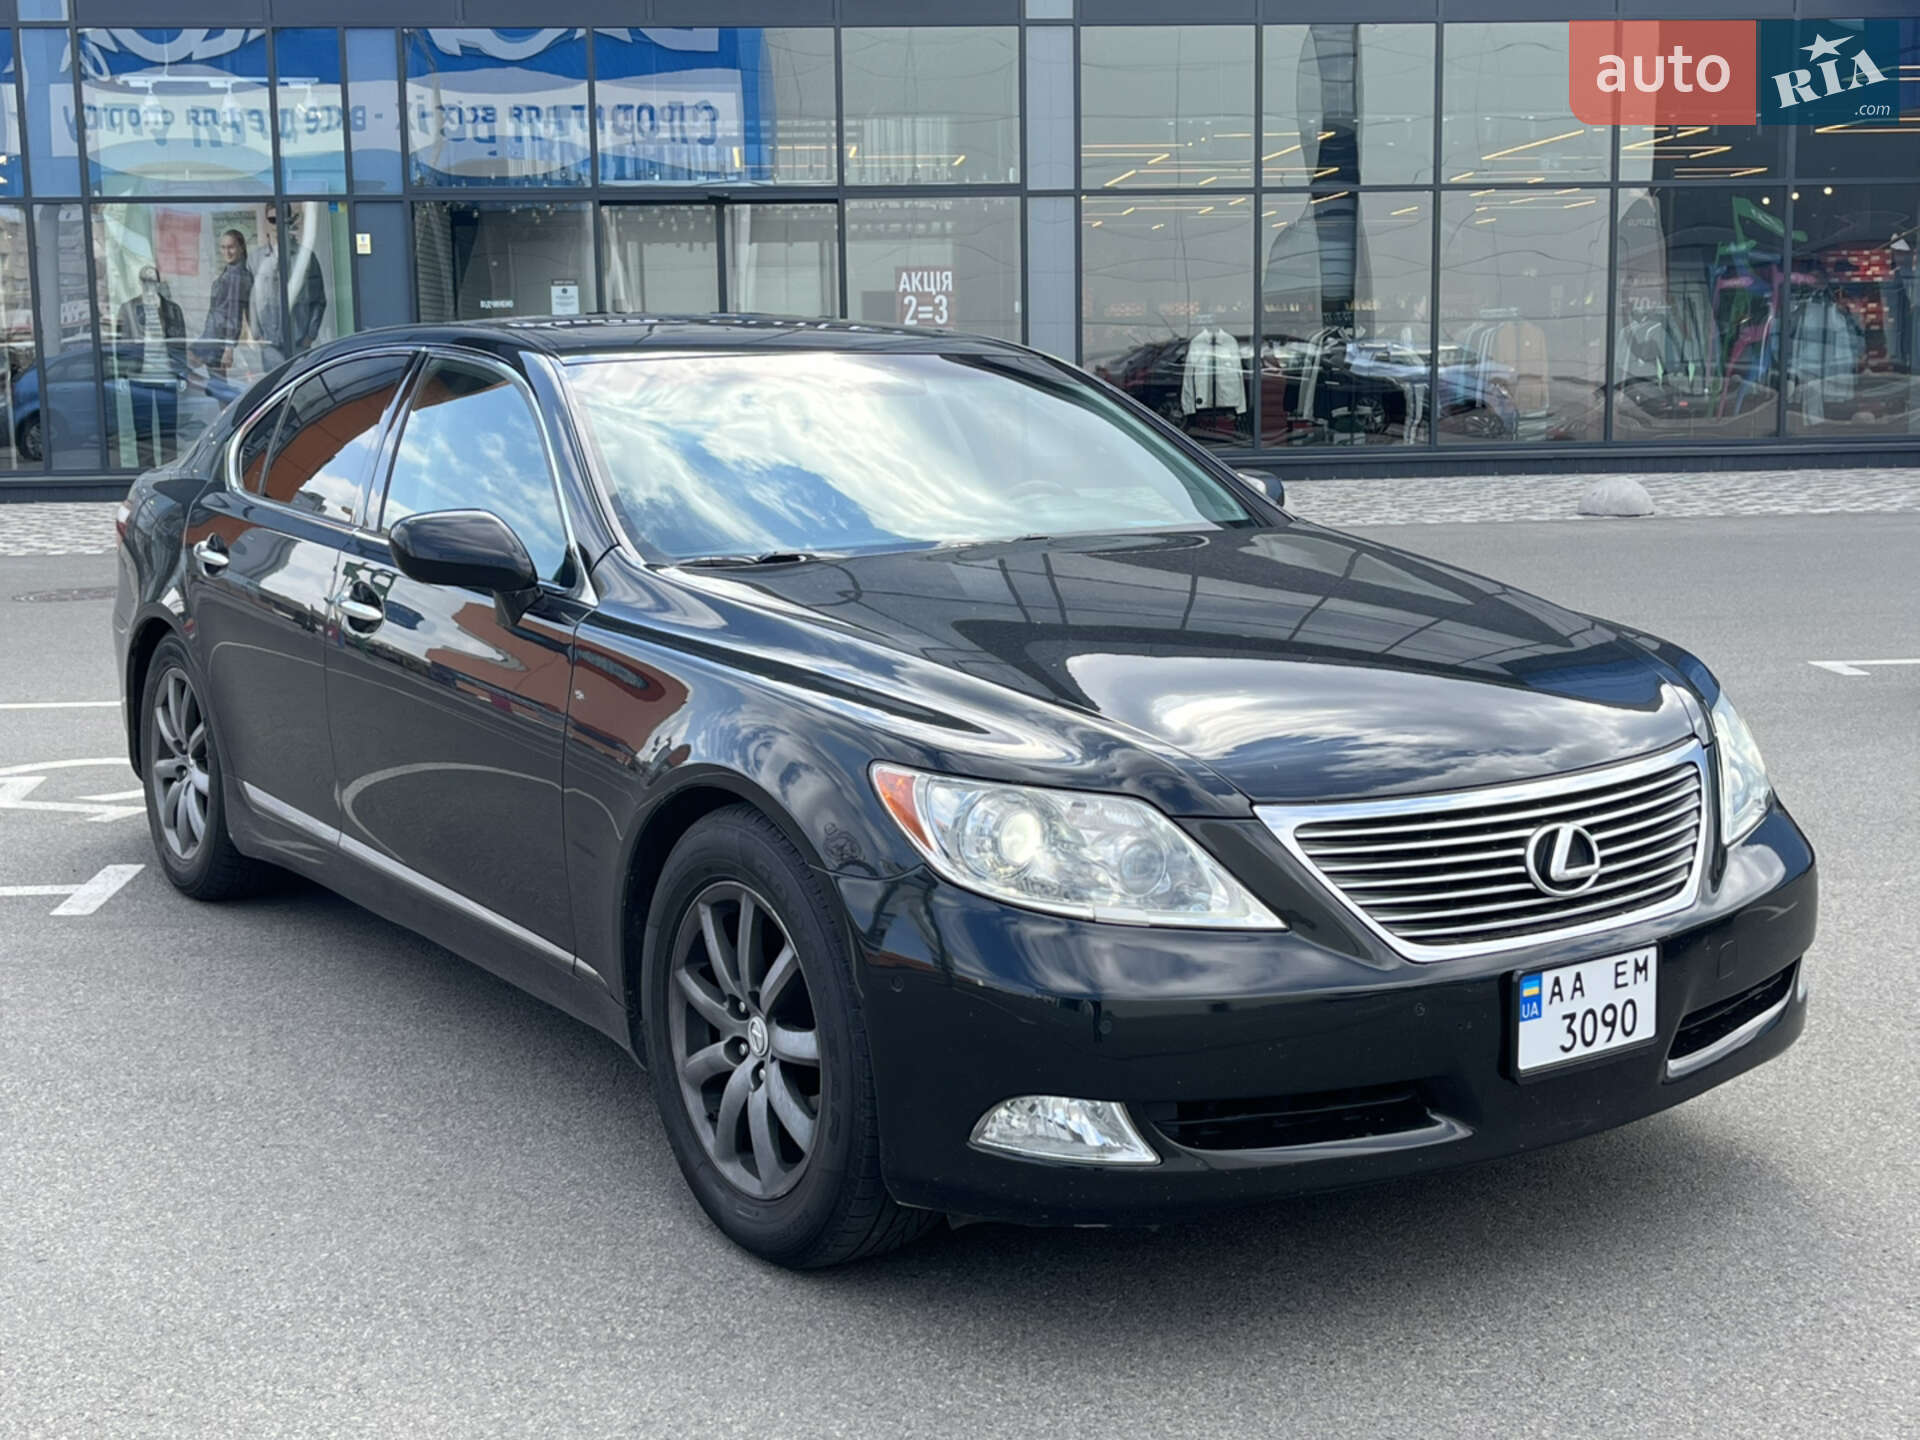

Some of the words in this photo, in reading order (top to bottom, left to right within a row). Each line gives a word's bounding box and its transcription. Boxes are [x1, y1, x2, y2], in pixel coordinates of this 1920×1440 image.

[899, 271, 953, 295] АКЦІЯ
[903, 295, 948, 325] 2=3
[1549, 971, 1585, 1005] AA
[1614, 955, 1649, 989] EM
[1522, 1002, 1539, 1019] UA
[1560, 998, 1637, 1053] 3090
